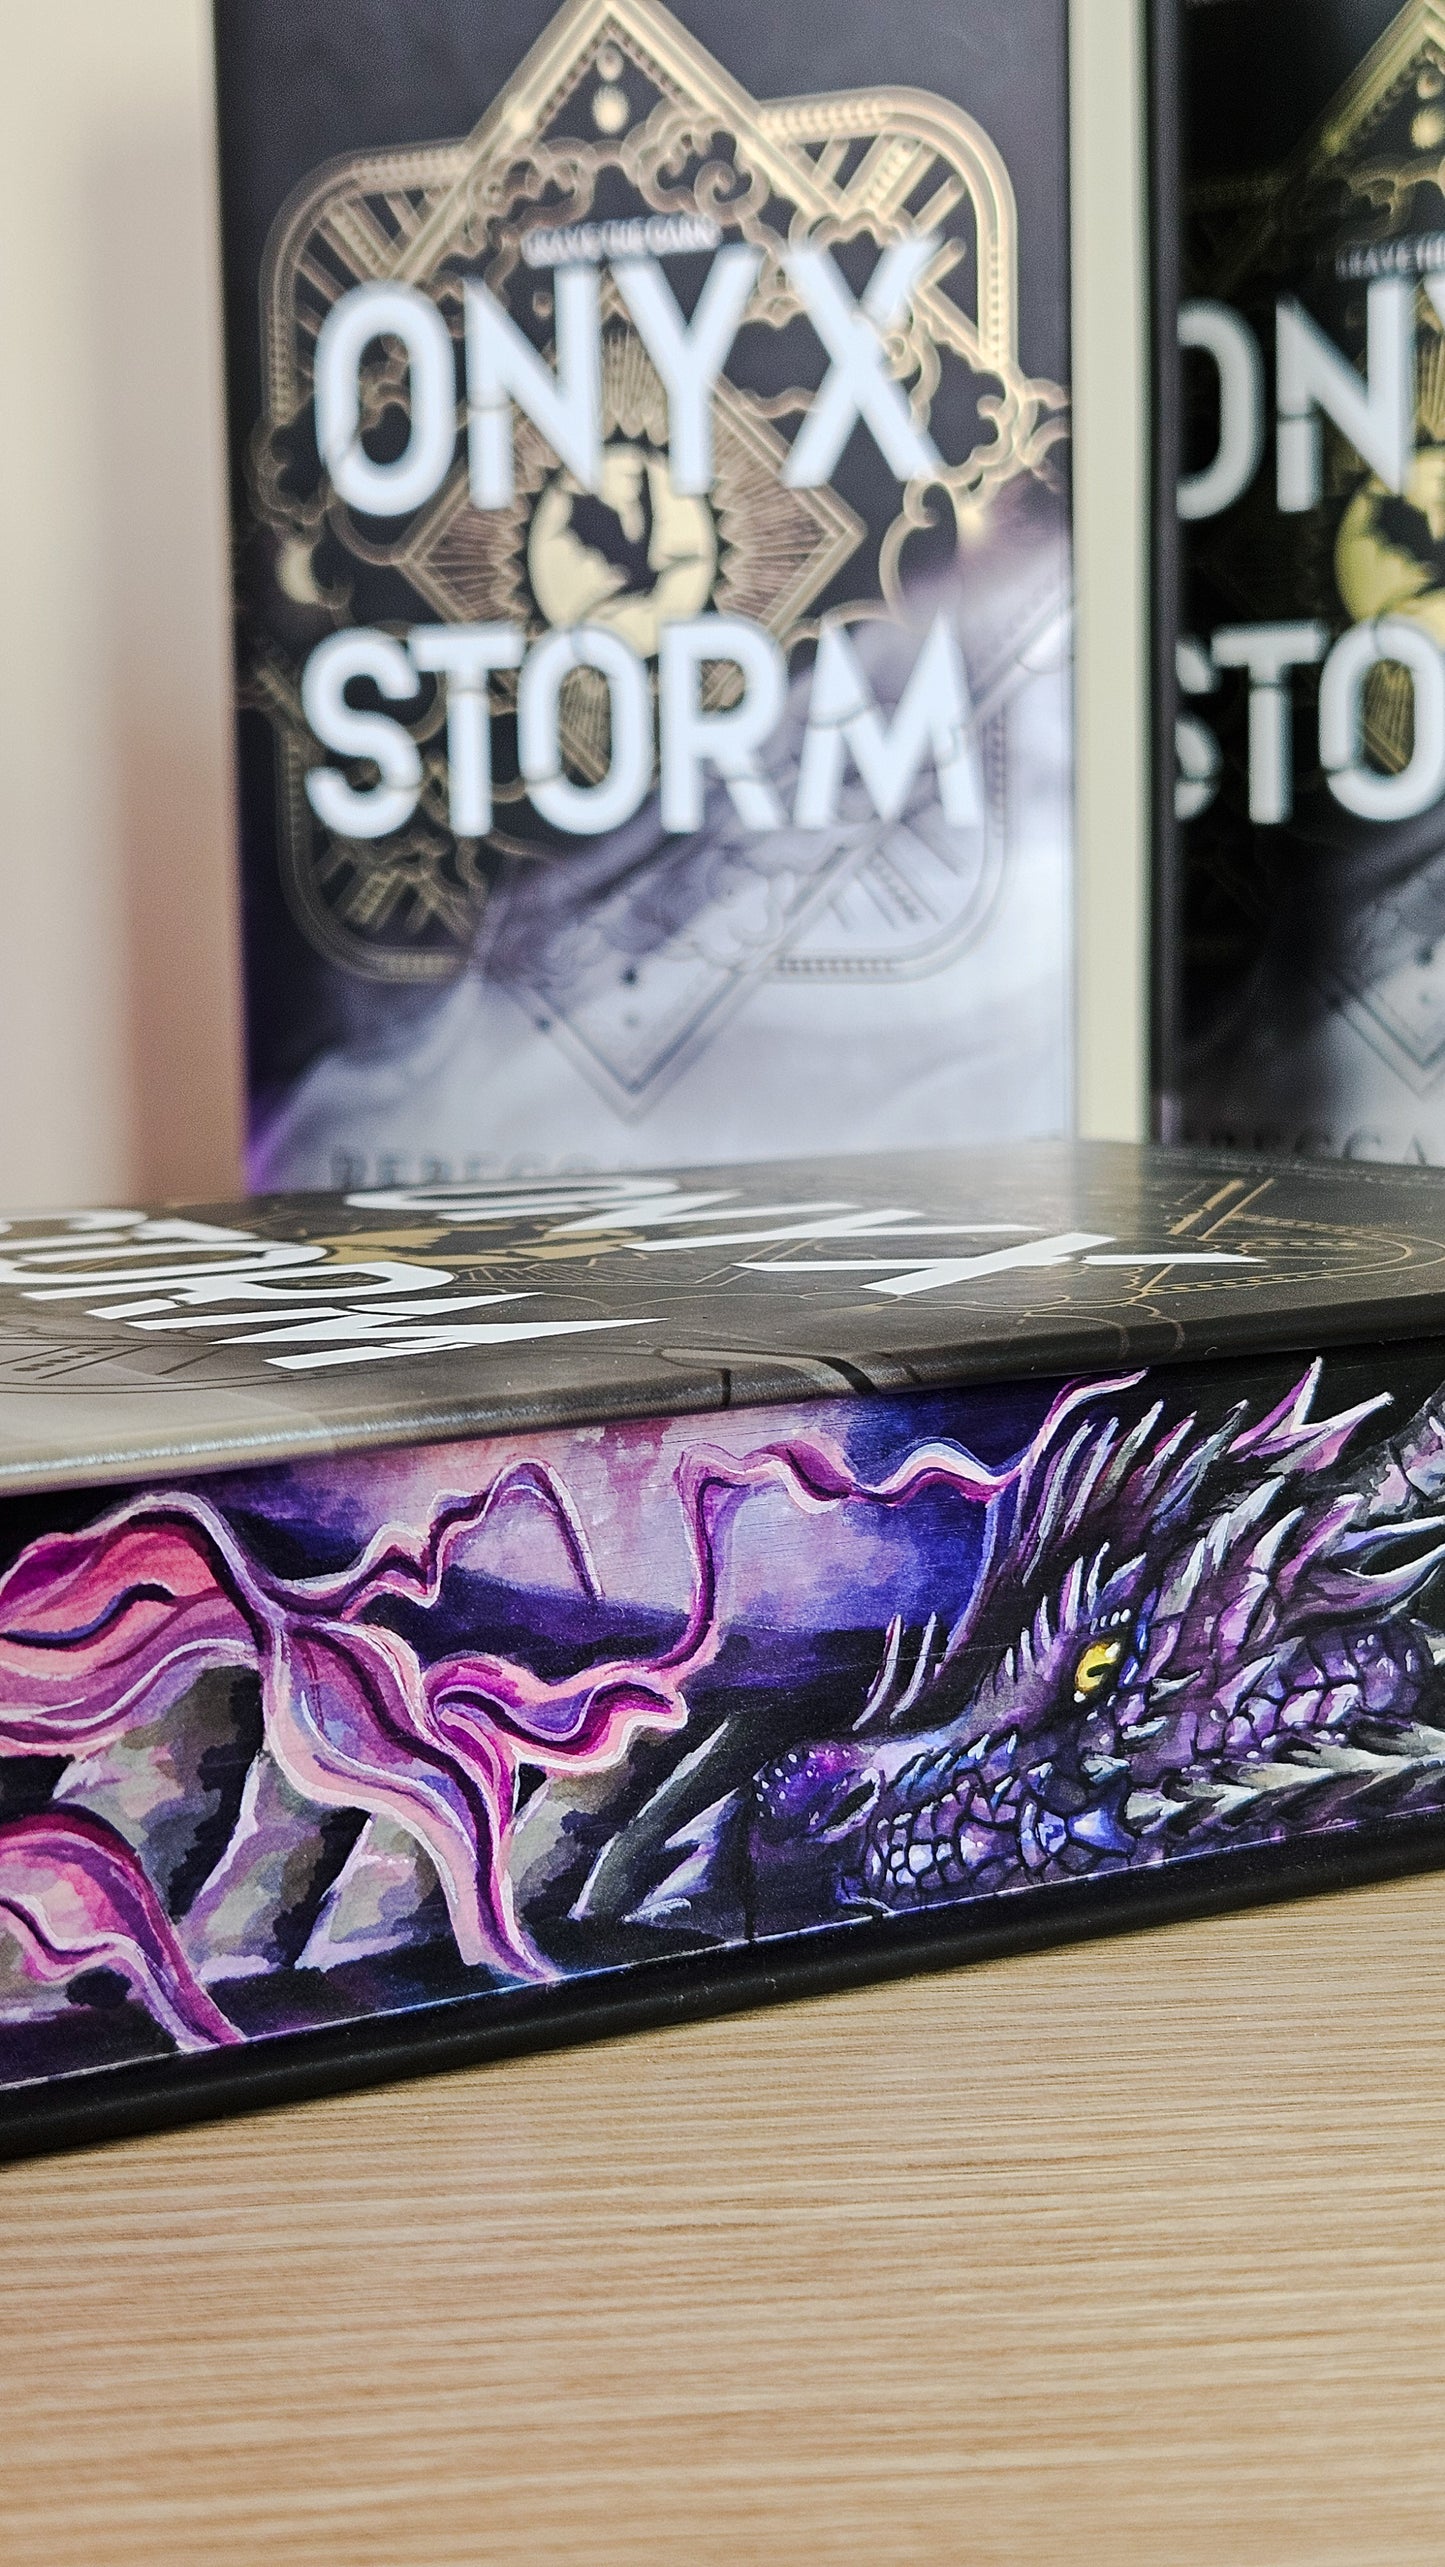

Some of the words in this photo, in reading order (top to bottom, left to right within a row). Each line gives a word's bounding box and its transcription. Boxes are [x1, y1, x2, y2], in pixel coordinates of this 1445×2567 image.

[313, 236, 942, 517] ONYX
[302, 610, 984, 839] STORM
[345, 1176, 1267, 1296] ONYX
